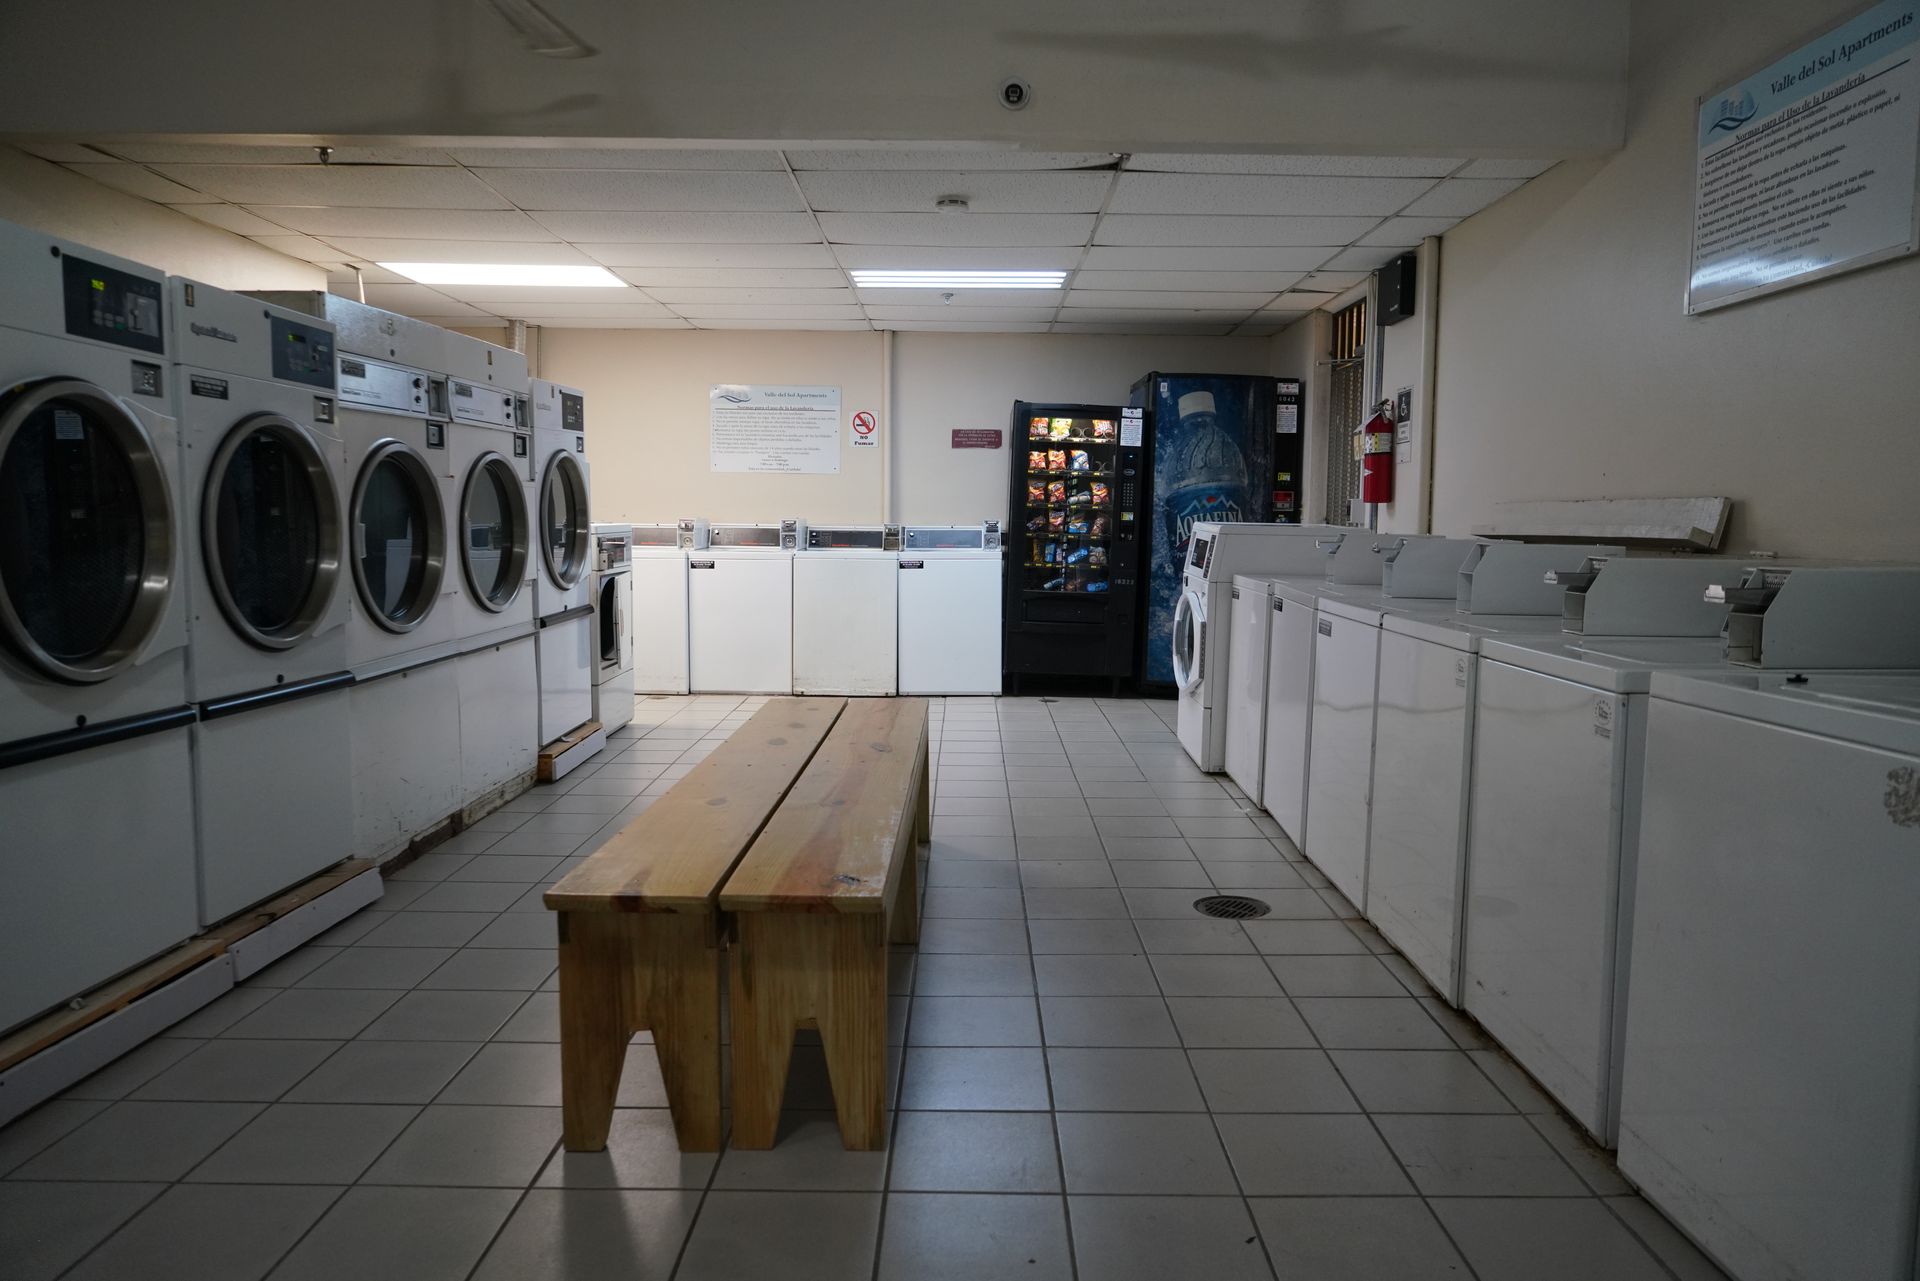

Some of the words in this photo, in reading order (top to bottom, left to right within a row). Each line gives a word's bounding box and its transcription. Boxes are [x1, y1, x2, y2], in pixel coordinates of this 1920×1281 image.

[1770, 74, 1796, 95] Valle
[1798, 60, 1816, 81] del
[1818, 50, 1836, 72] Sol
[1838, 12, 1914, 62] Apartments
[1735, 125, 1759, 142] Normas
[1822, 73, 1865, 100] Lavandería
